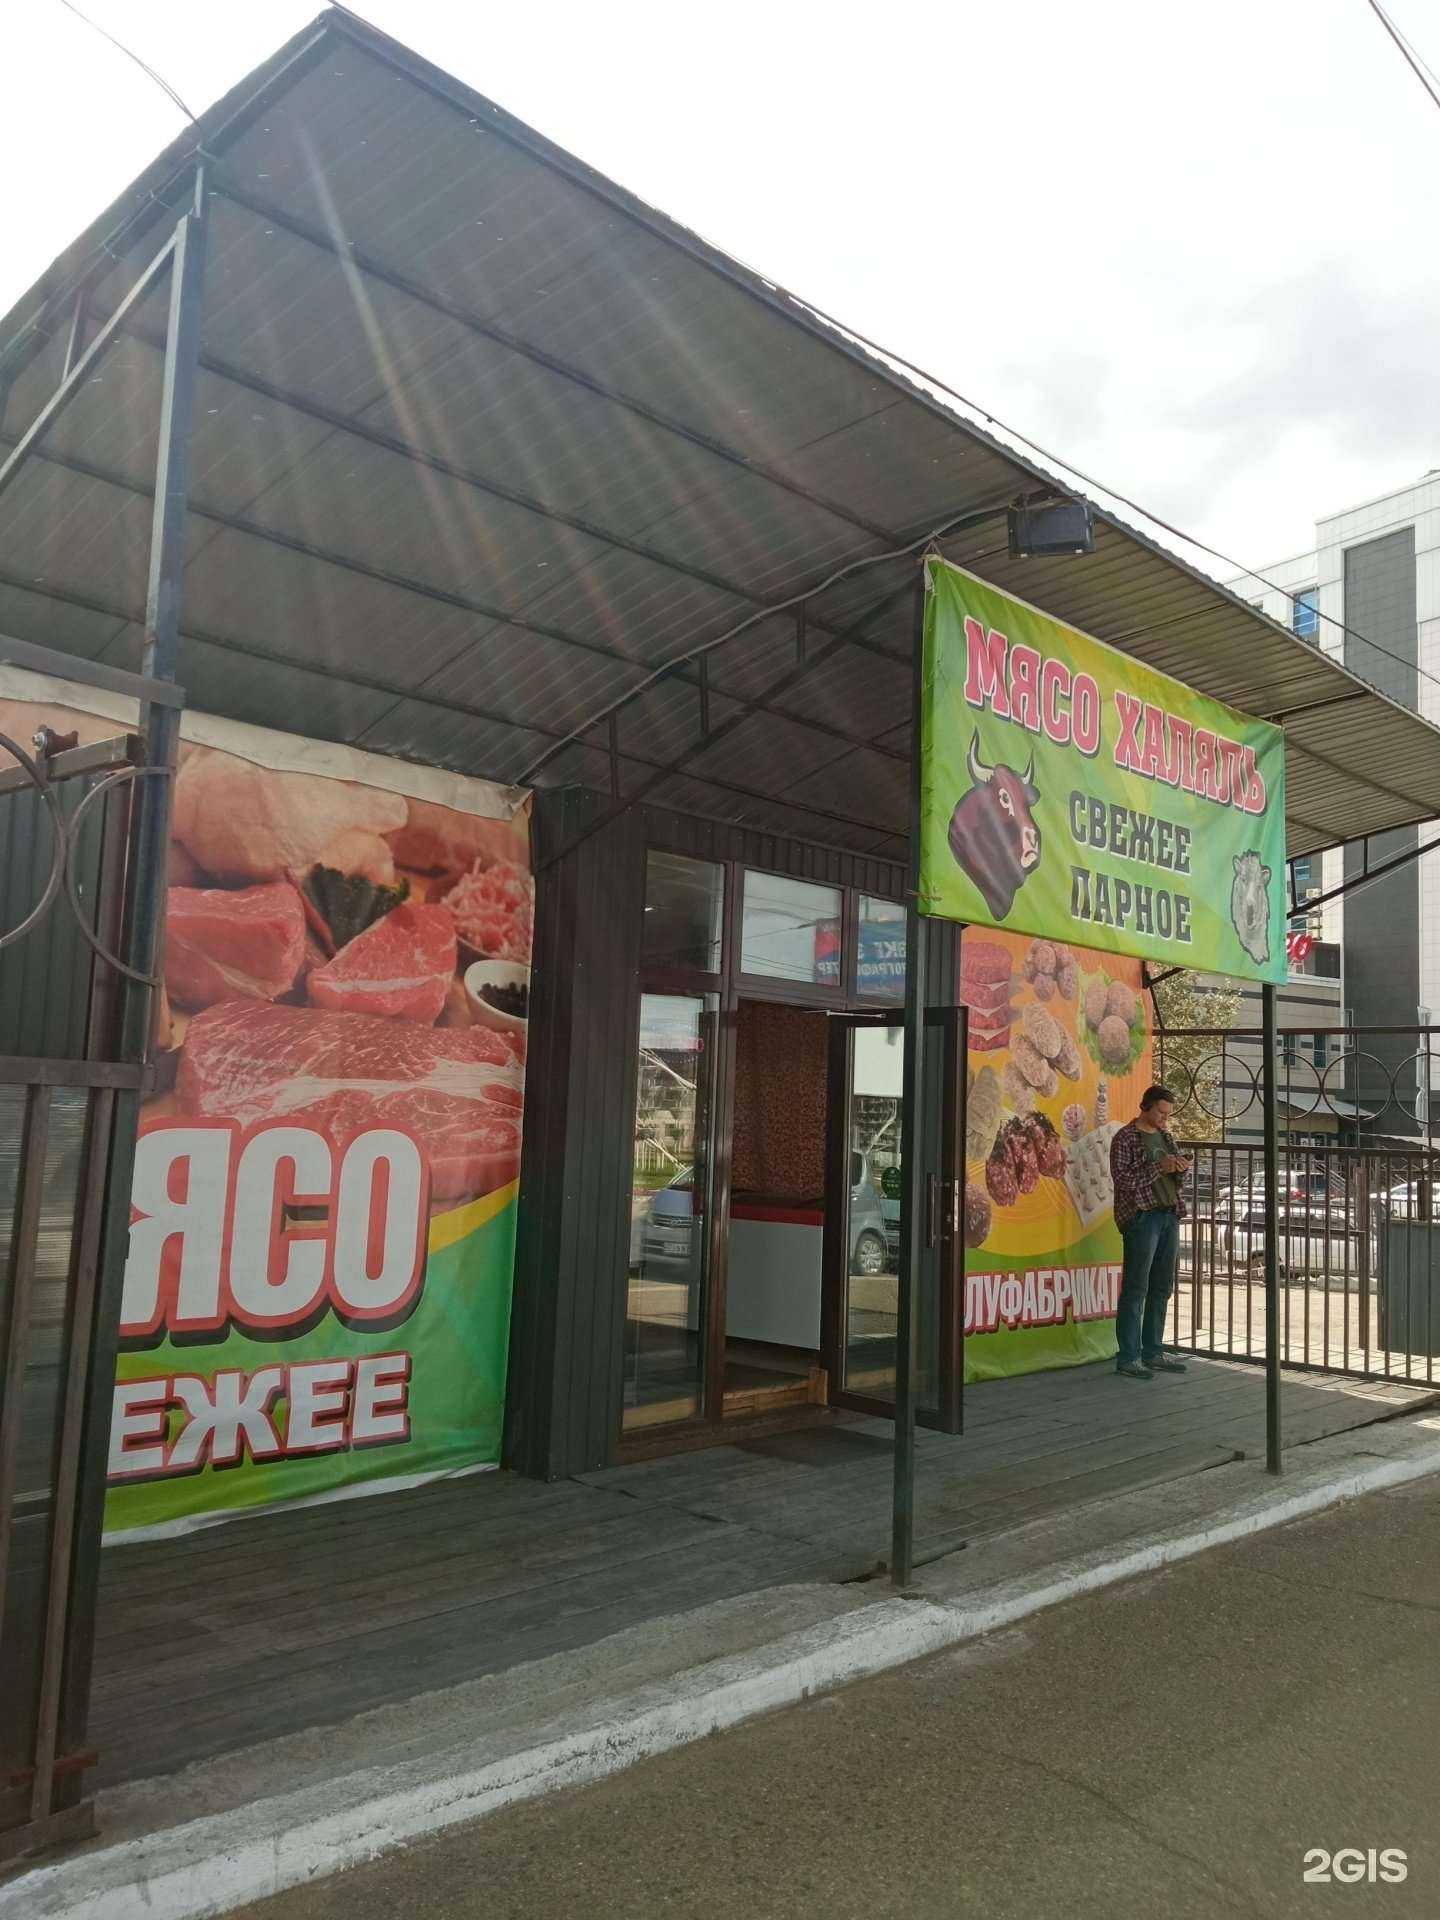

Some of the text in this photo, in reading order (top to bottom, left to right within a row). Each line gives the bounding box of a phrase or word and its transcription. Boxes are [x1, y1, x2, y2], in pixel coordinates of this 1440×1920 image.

[963, 614, 1268, 818] МЯСО ХАЛЯЛЬ
[1067, 789, 1192, 876] СВЕЖЕЕ
[1069, 864, 1193, 945] ПАРНОЕ
